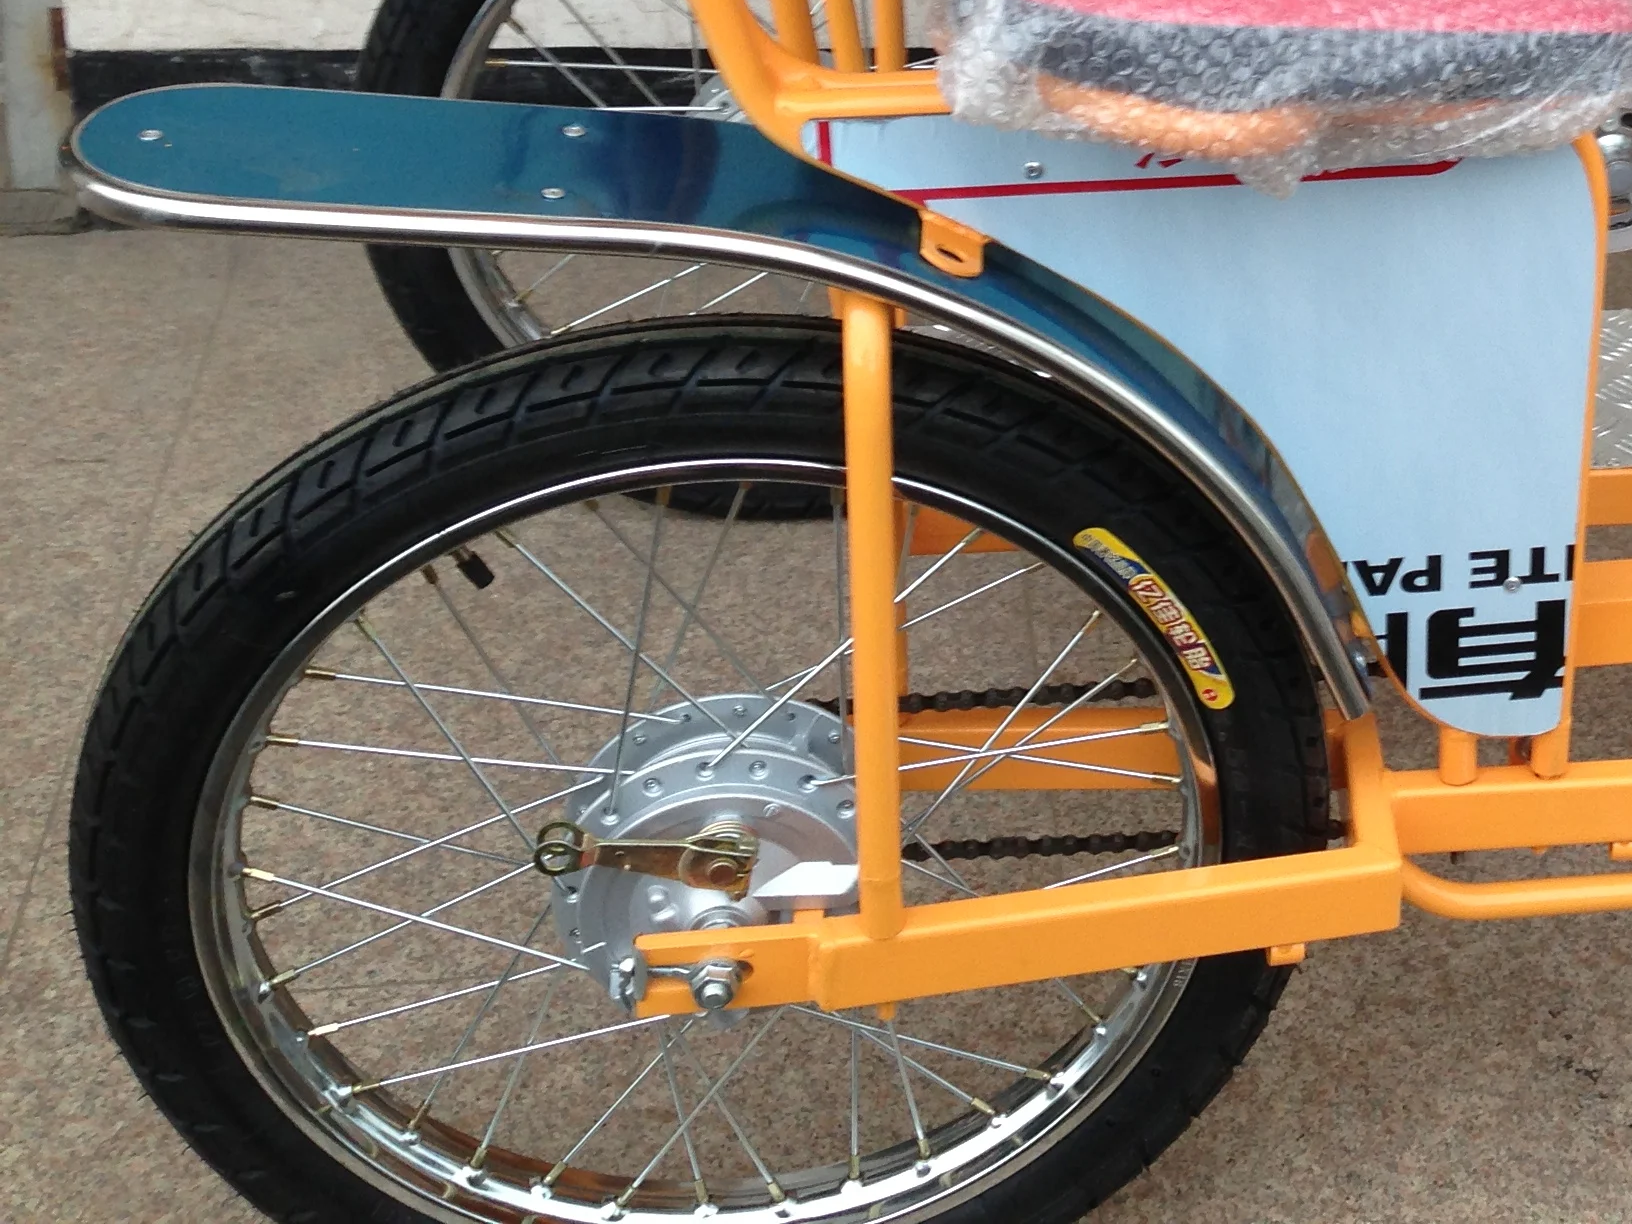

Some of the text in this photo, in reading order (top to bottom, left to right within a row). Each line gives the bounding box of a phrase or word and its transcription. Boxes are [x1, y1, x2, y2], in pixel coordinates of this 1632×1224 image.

[1343, 554, 1441, 596] PA
[1131, 580, 1211, 669] 亿佳轮胎
